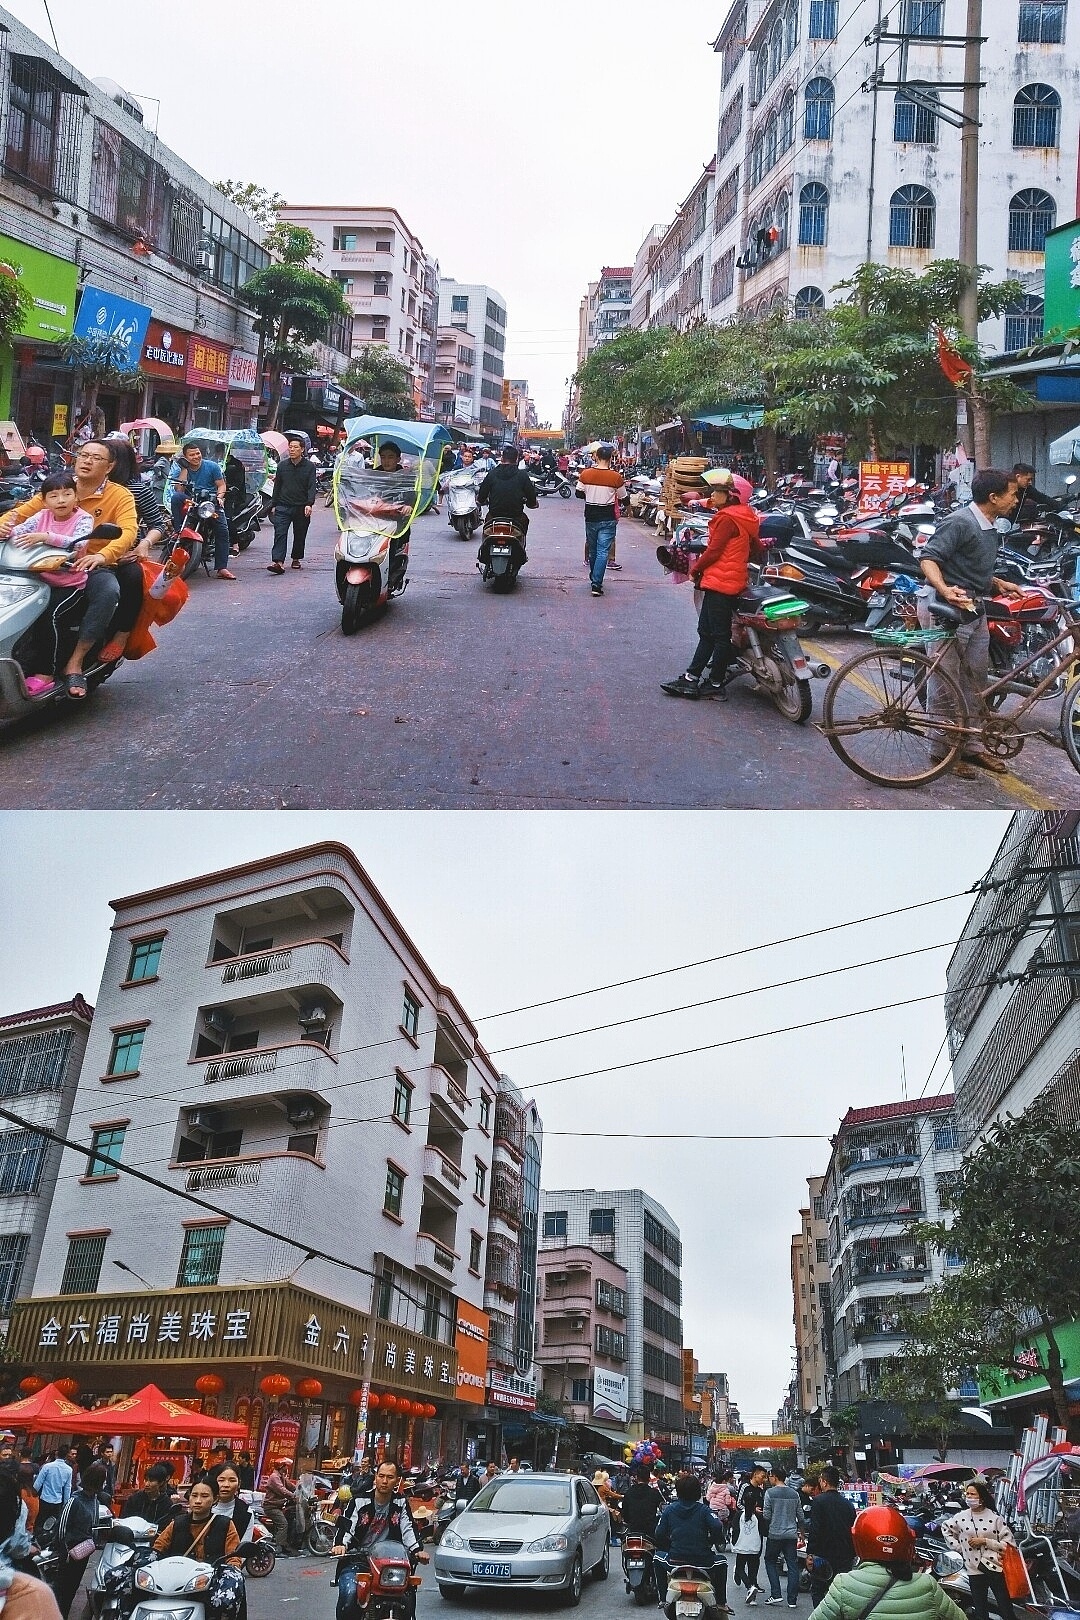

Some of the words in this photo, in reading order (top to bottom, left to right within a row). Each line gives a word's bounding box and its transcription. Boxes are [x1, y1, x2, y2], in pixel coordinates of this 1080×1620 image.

[862, 463, 908, 475] 福建千里香
[862, 475, 907, 492] 云吞
[38, 1308, 251, 1347] 金六福尚美珠宝
